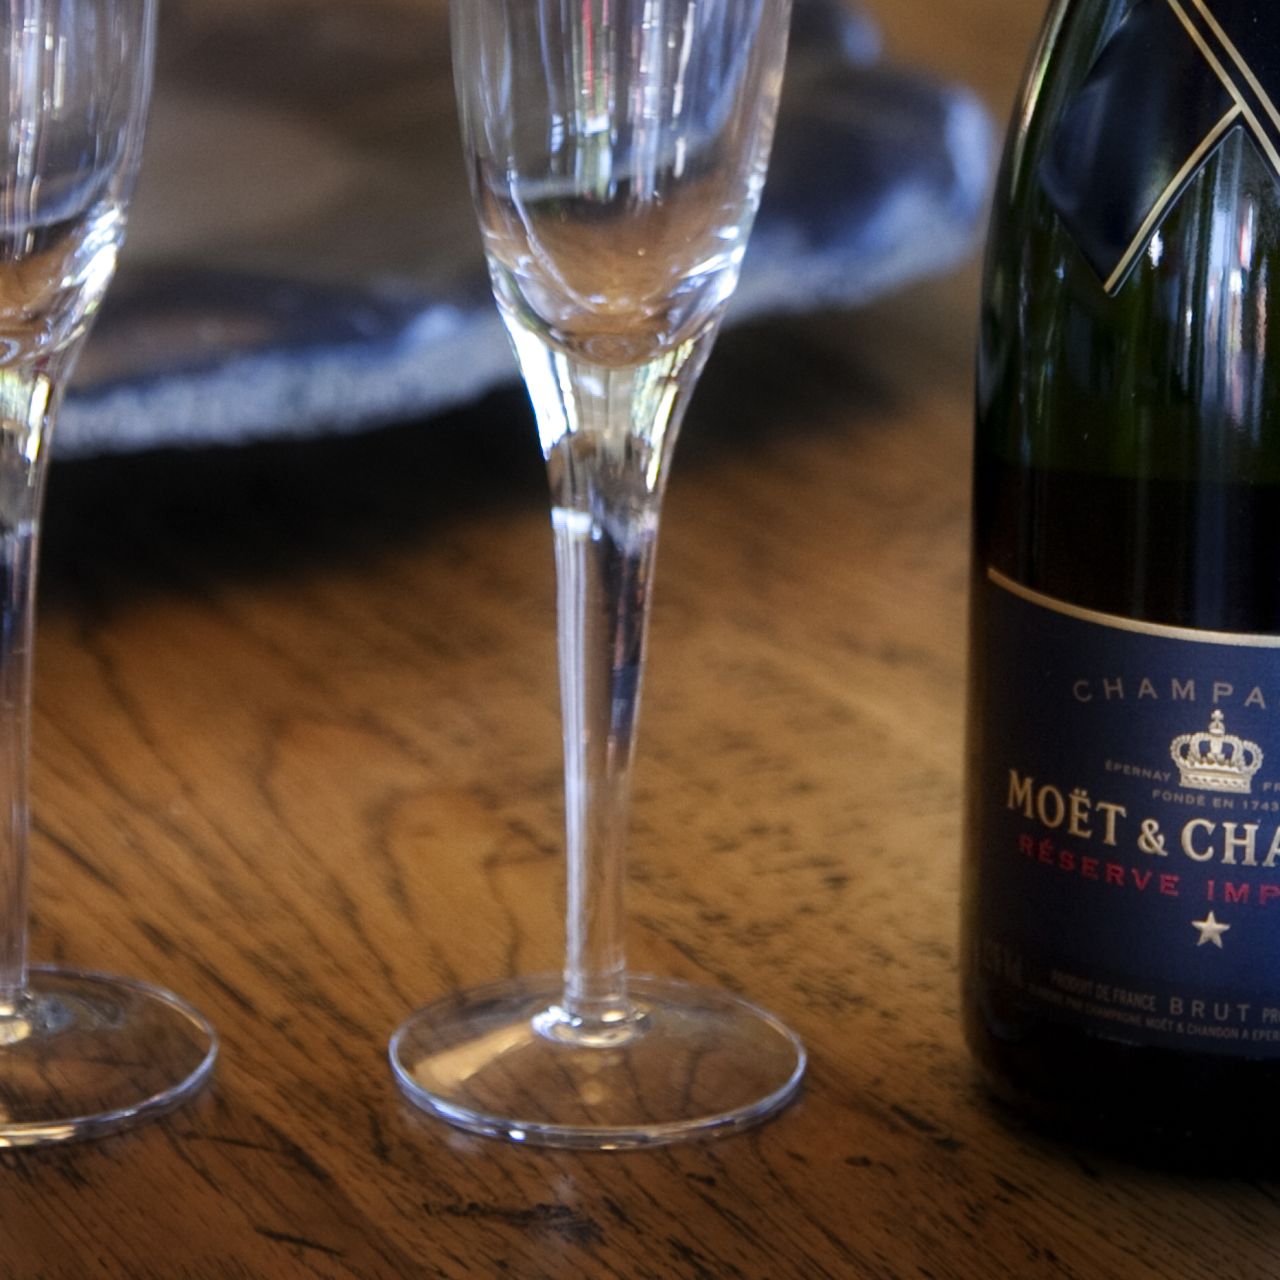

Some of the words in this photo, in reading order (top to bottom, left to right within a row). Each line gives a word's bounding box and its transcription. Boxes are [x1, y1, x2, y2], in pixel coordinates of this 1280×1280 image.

[1104, 760, 1171, 783] ÉPERNAY
[1006, 768, 1127, 846] MOËT
[1136, 818, 1168, 858] &
[1152, 788, 1207, 807] FONDÉ
[1213, 796, 1235, 810] EN
[1242, 799, 1280, 812] 1743
[1018, 833, 1181, 897] RÉSERVE
[1111, 986, 1157, 1012] FRANCE
[1169, 996, 1251, 1023] BRUT
